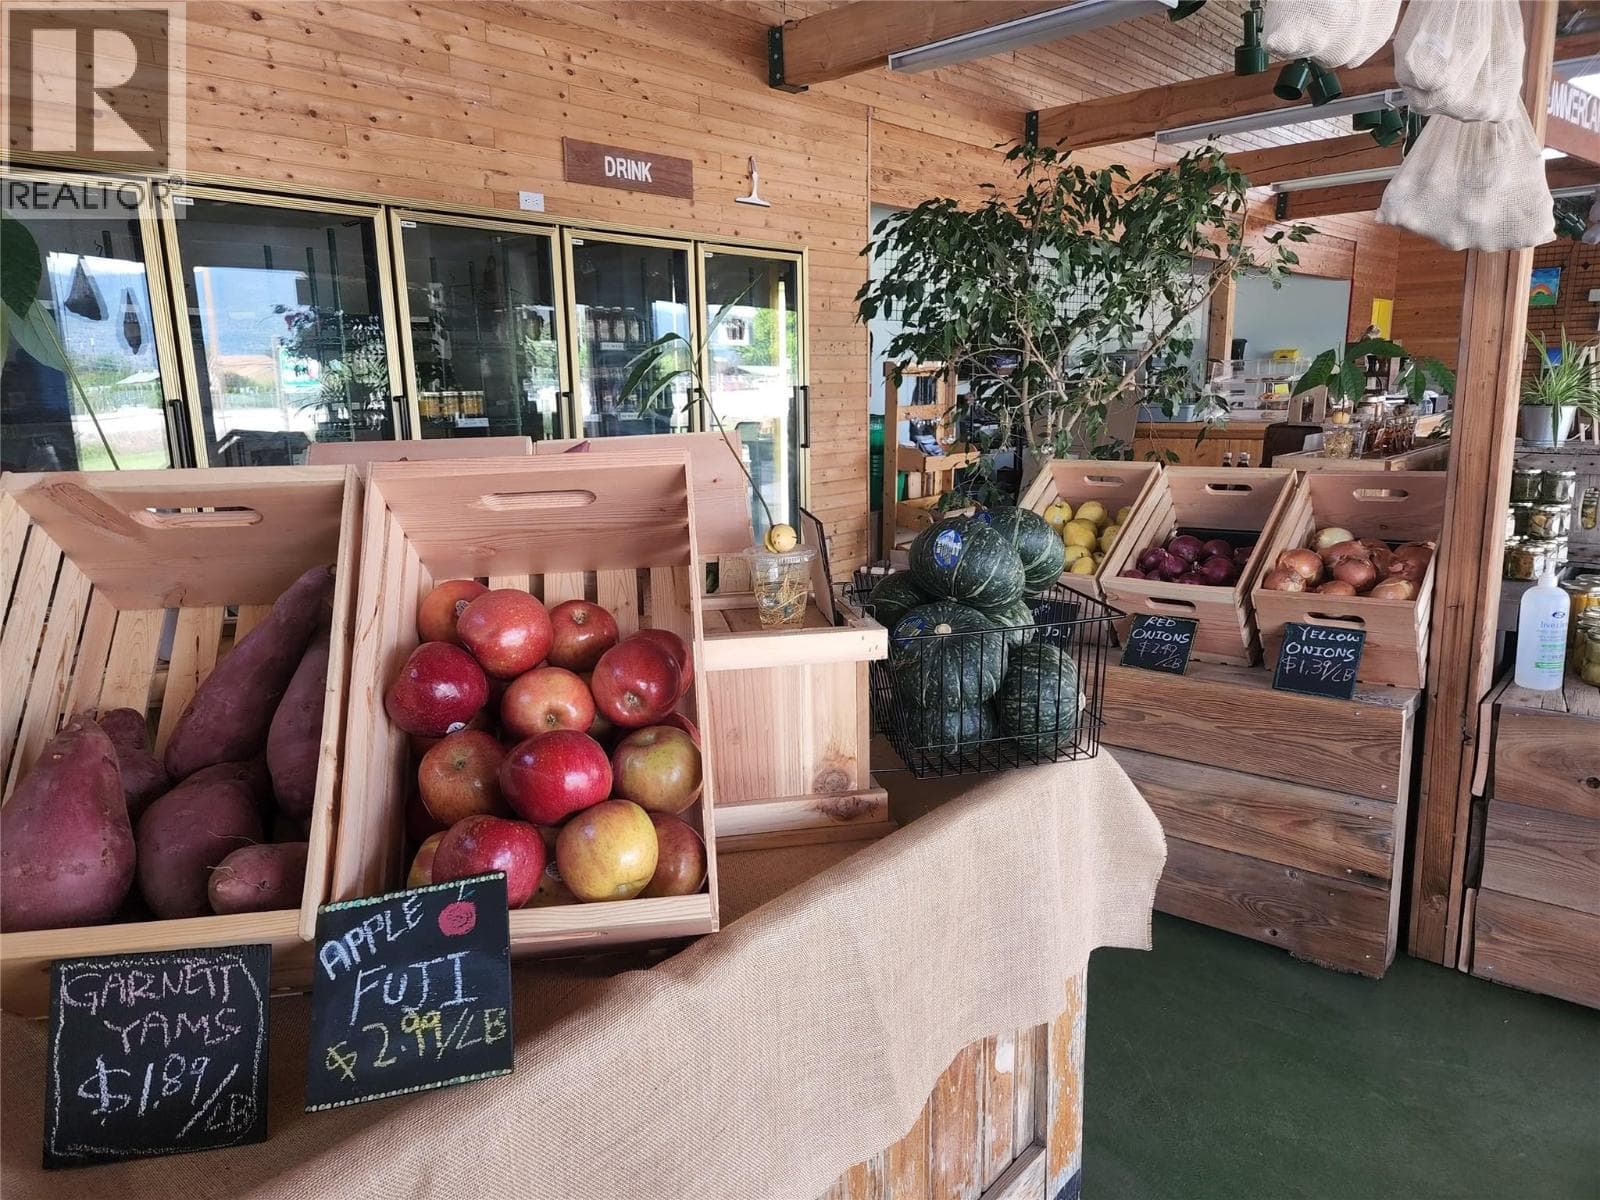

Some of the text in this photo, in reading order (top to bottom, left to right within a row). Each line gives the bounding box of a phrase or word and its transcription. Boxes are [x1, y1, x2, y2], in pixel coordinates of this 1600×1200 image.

[604, 155, 652, 183] DRINK
[1143, 616, 1176, 627] RED
[1298, 625, 1360, 641] YELLOW
[1131, 628, 1190, 644] ONIONS
[1286, 641, 1356, 662] ONIONS
[319, 893, 424, 981] APPLE
[61, 963, 240, 1016] GARNETT
[349, 950, 479, 1027] FUJI
[103, 1007, 242, 1055] YAMS
